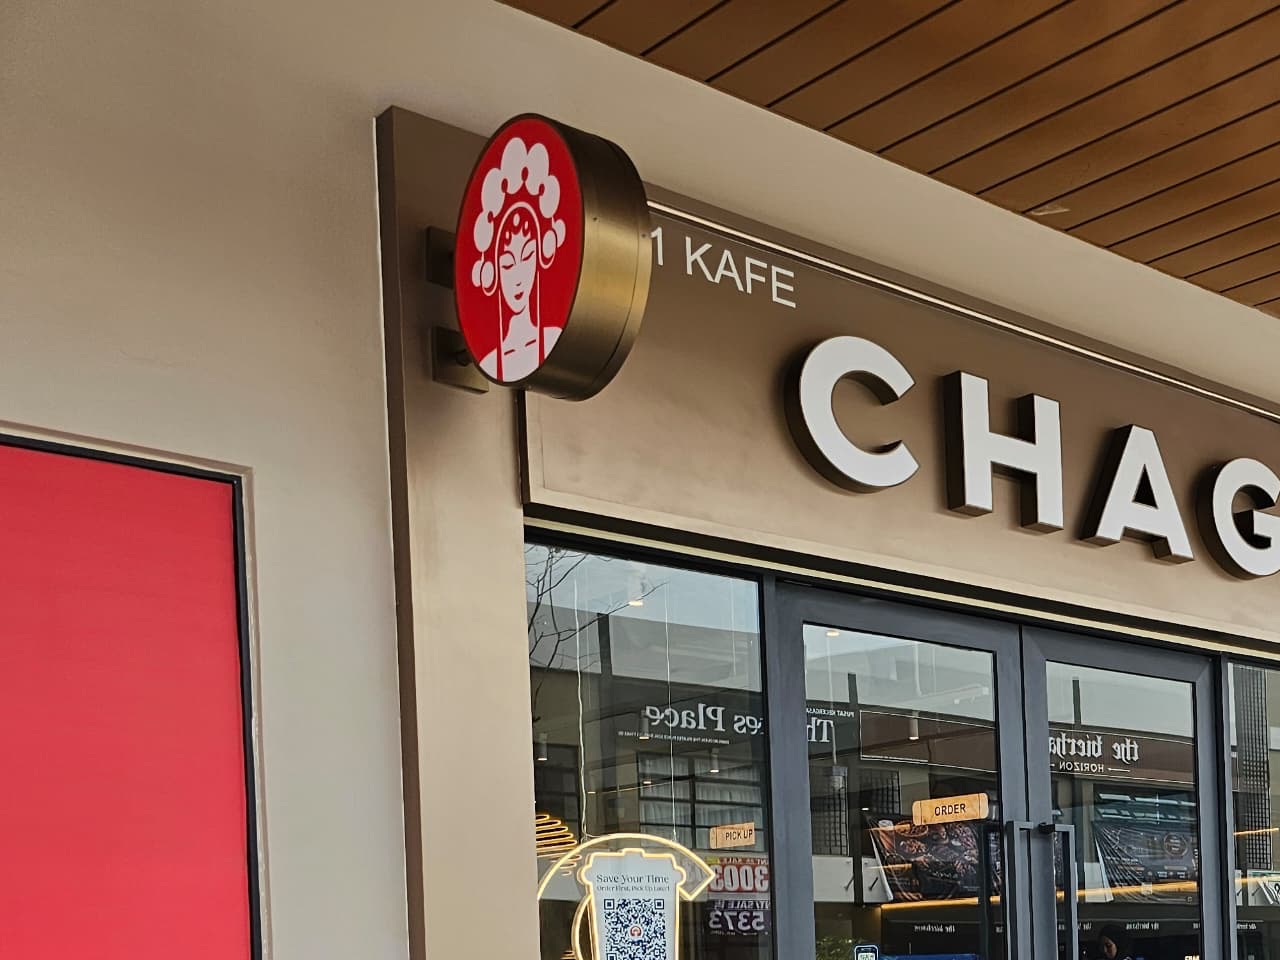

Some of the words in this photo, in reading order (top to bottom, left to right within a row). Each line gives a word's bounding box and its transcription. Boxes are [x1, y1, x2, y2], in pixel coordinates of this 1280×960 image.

[685, 236, 797, 309] KAFE
[934, 803, 966, 816] ORDER
[725, 830, 742, 841] PICK
[743, 829, 753, 839] UP
